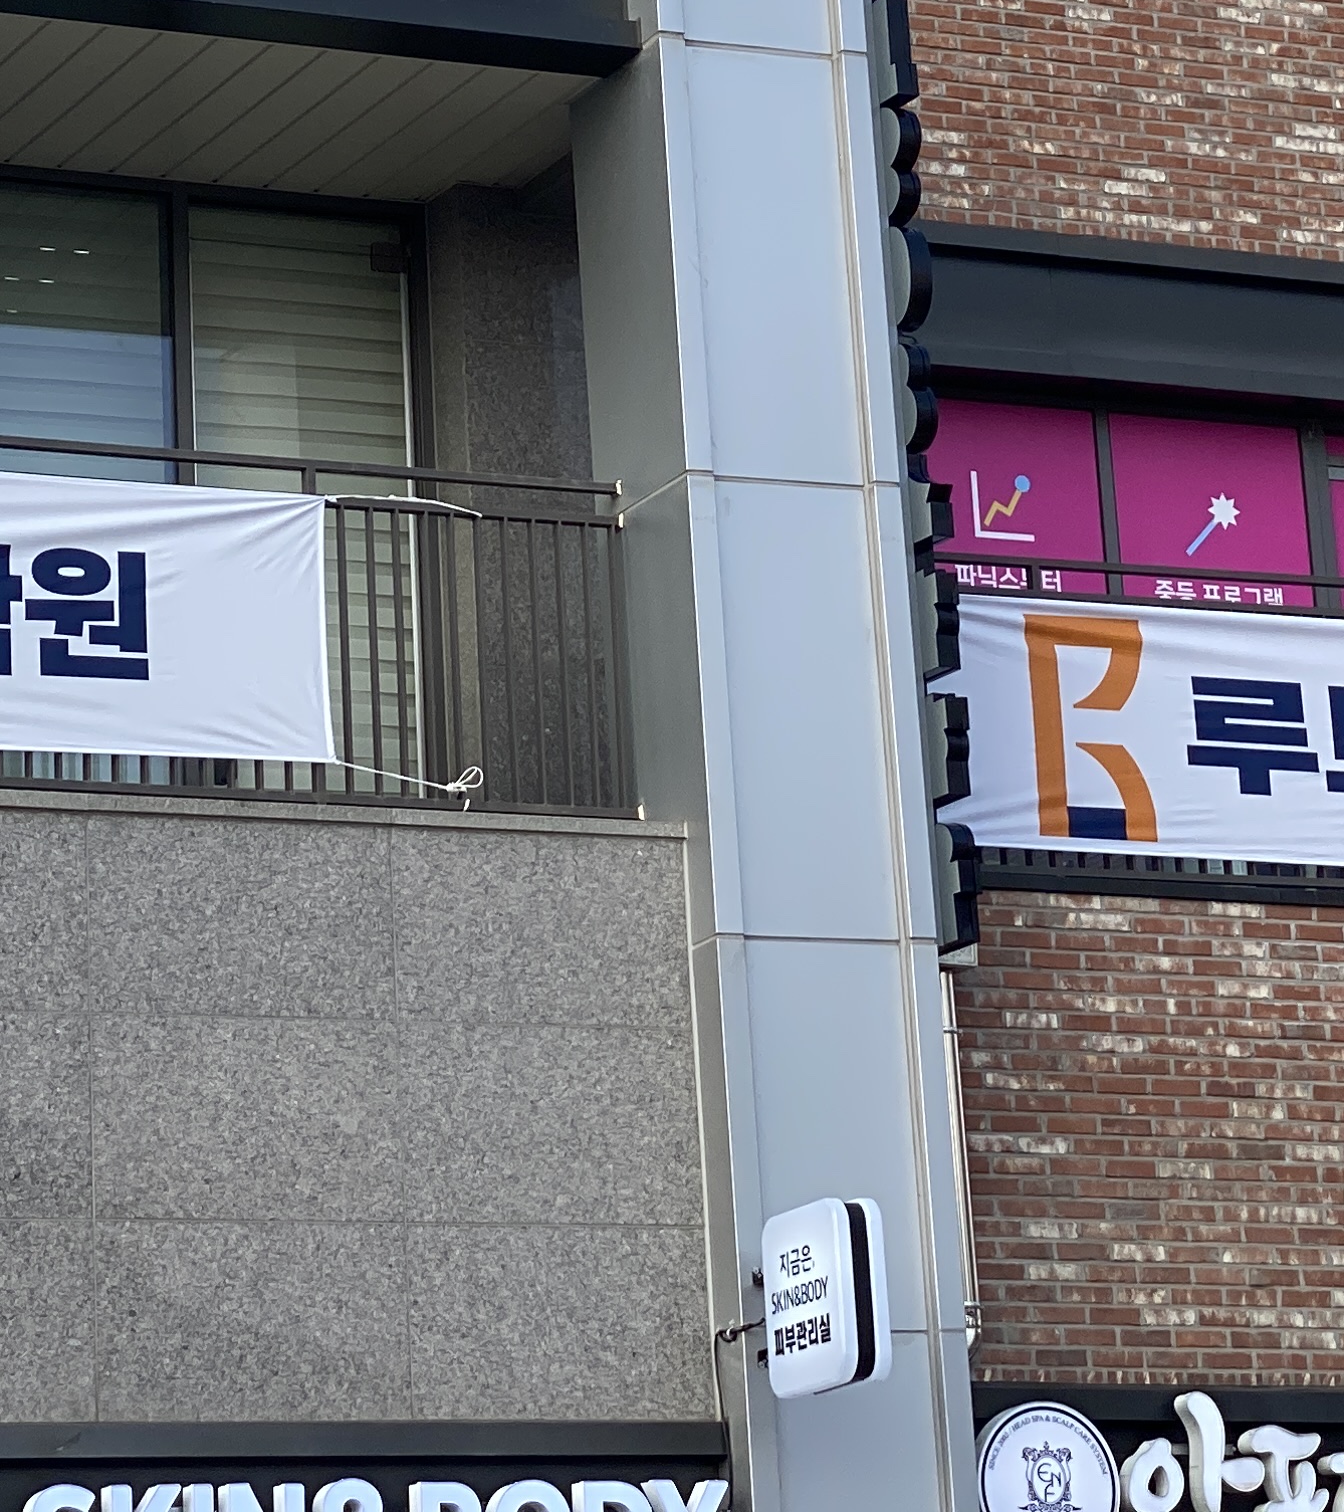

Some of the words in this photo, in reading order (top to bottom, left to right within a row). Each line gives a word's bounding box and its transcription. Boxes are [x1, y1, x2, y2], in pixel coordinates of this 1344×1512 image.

[779, 1244, 815, 1279] 지금은
[771, 1276, 829, 1315] SKIN&BODY
[773, 1312, 832, 1356] 피부관리실
